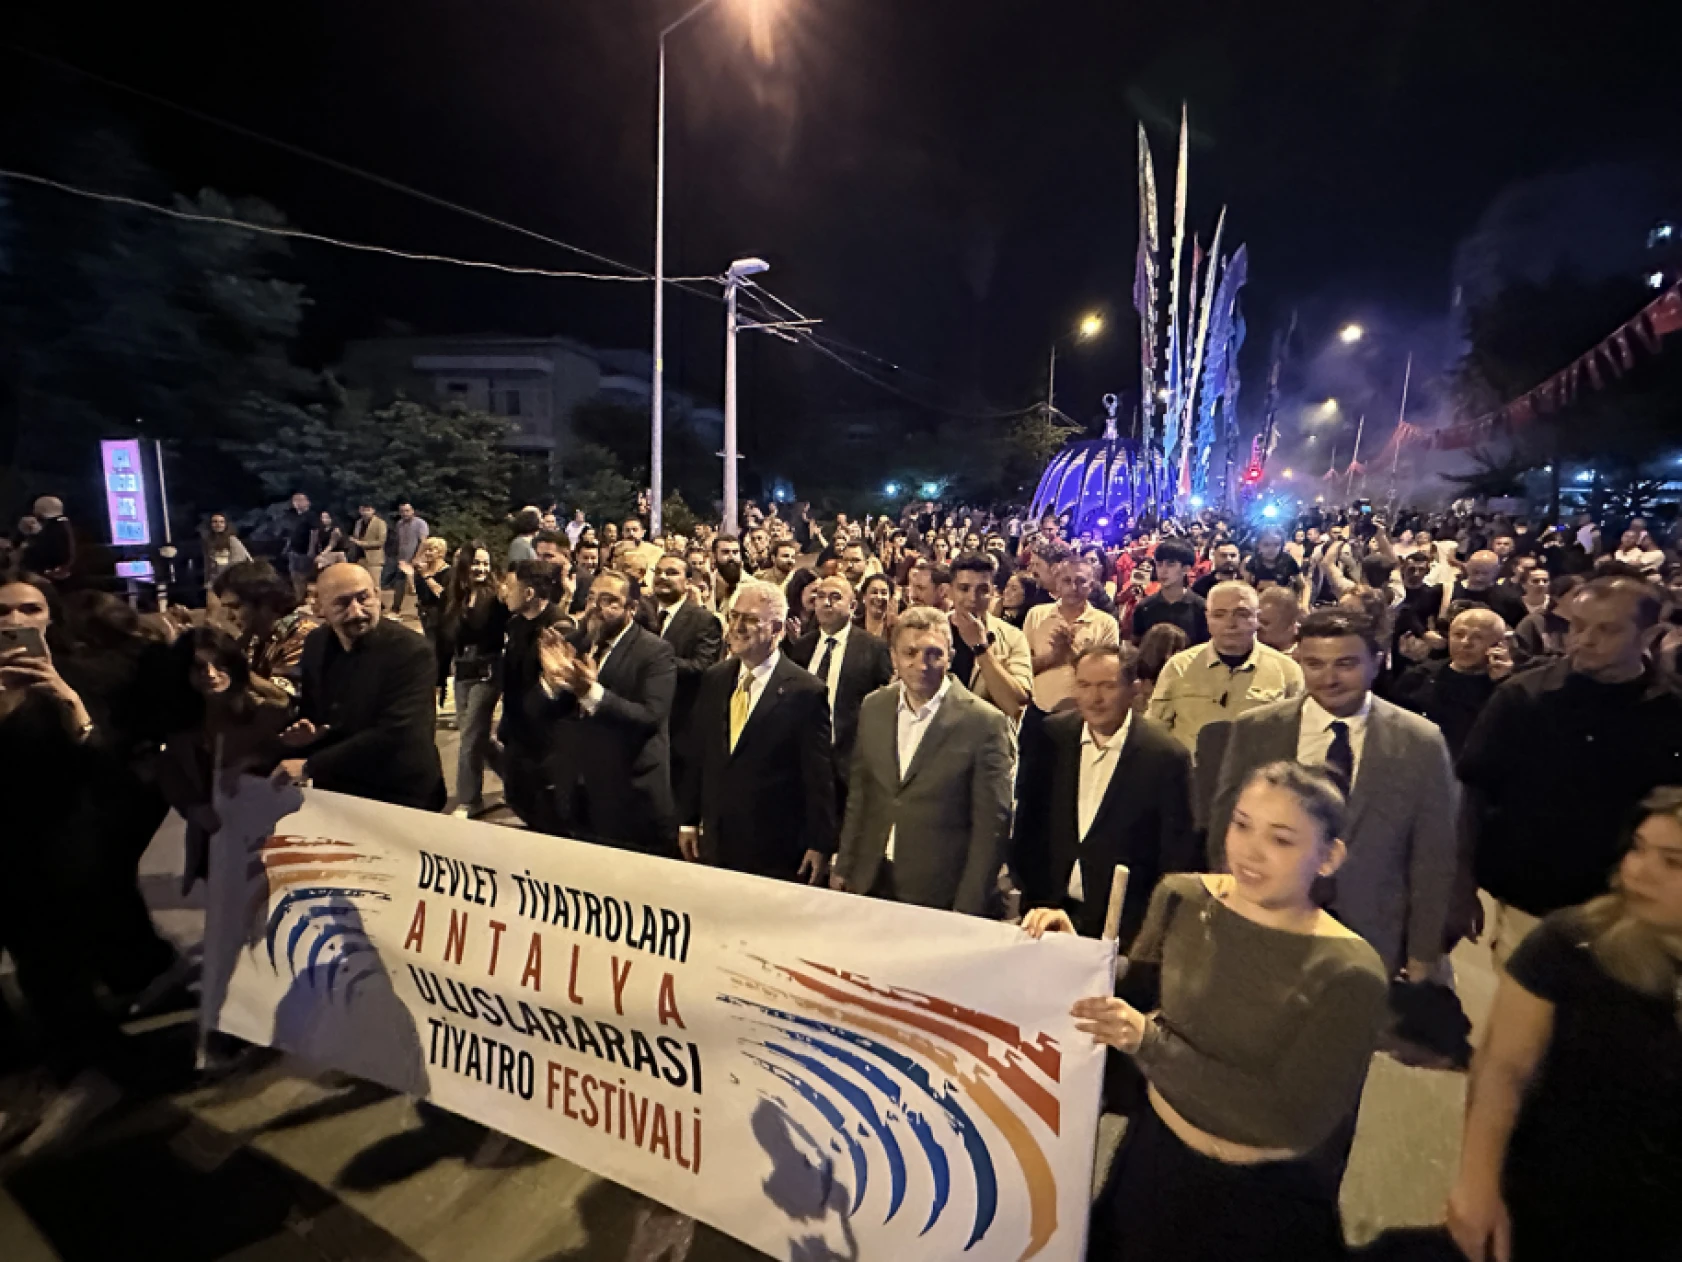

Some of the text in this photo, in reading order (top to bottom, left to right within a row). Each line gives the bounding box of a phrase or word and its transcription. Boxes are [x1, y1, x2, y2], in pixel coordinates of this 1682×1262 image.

[403, 899, 686, 1030] ANTALYA
[418, 850, 692, 963] DEVLET TİYATROLARI
[407, 963, 703, 1095] ULUSLARARASI
[428, 1016, 703, 1175] TİYATRO FESTİVALİ
